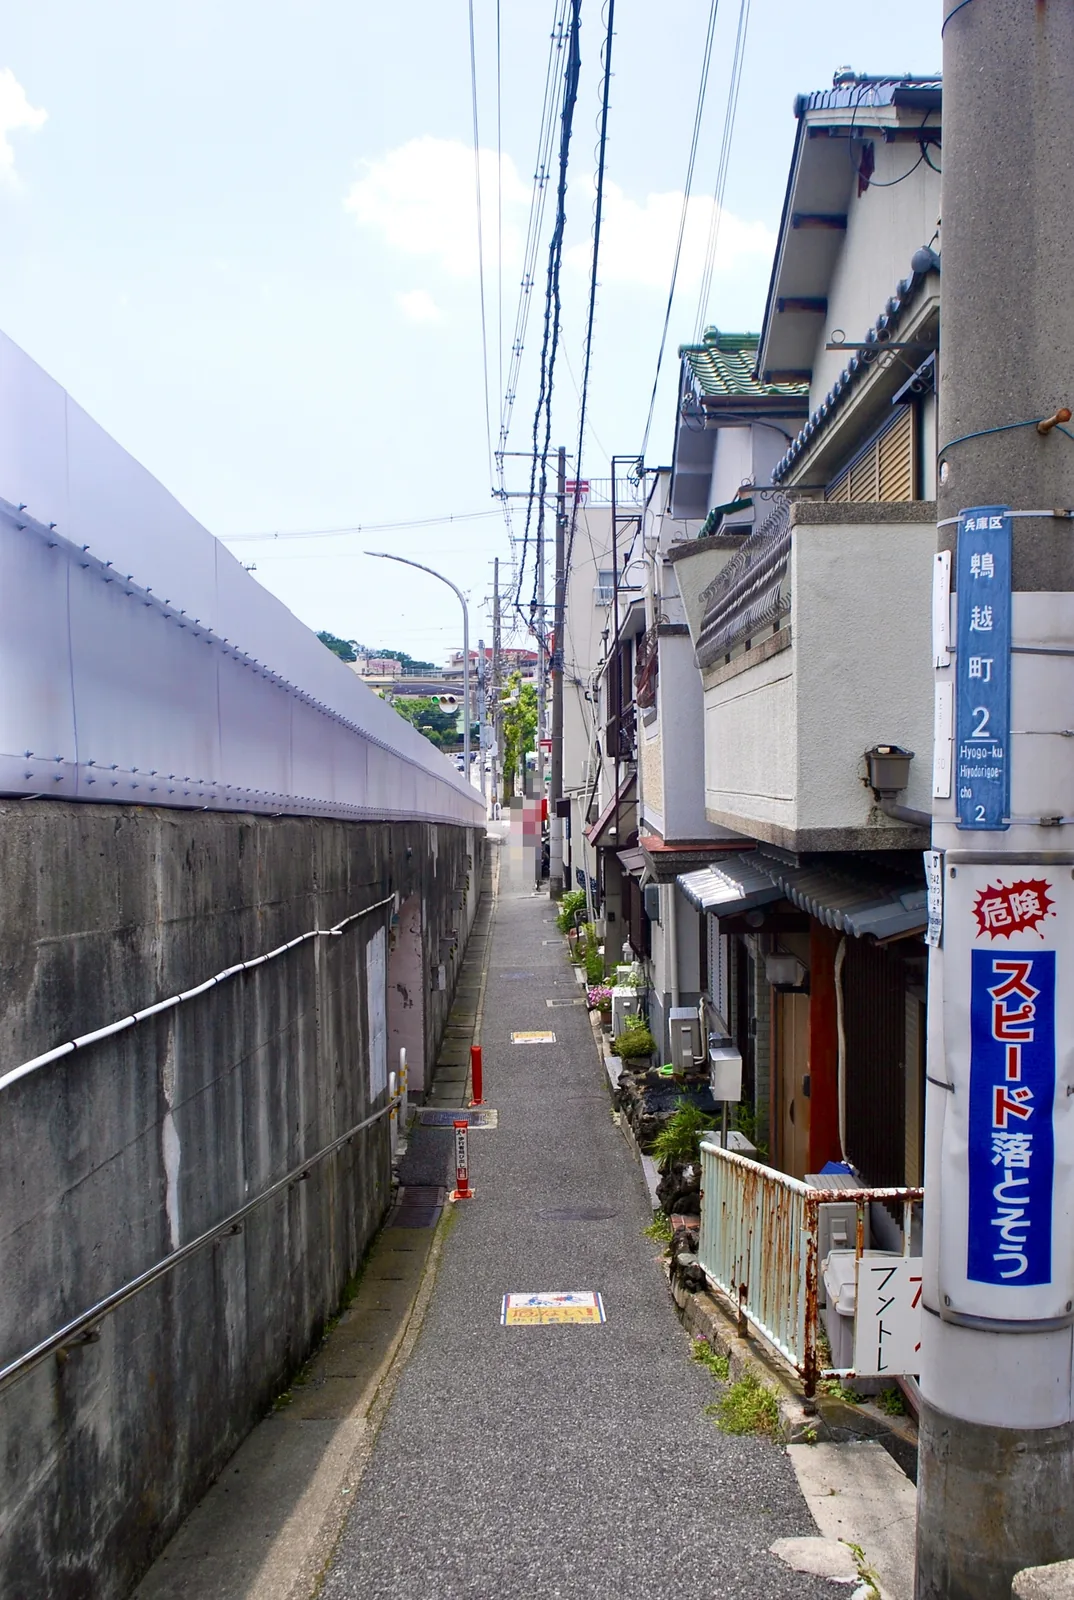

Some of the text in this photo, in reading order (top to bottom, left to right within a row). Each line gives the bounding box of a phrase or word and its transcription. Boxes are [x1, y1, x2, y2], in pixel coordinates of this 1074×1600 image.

[964, 515, 1003, 532] 兵庫区
[960, 745, 1003, 759] Hyogo-ku
[960, 765, 1002, 779] Hiyodorigoe-
[960, 786, 972, 799] cho
[974, 805, 986, 822] 2
[979, 889, 1043, 929] 危険
